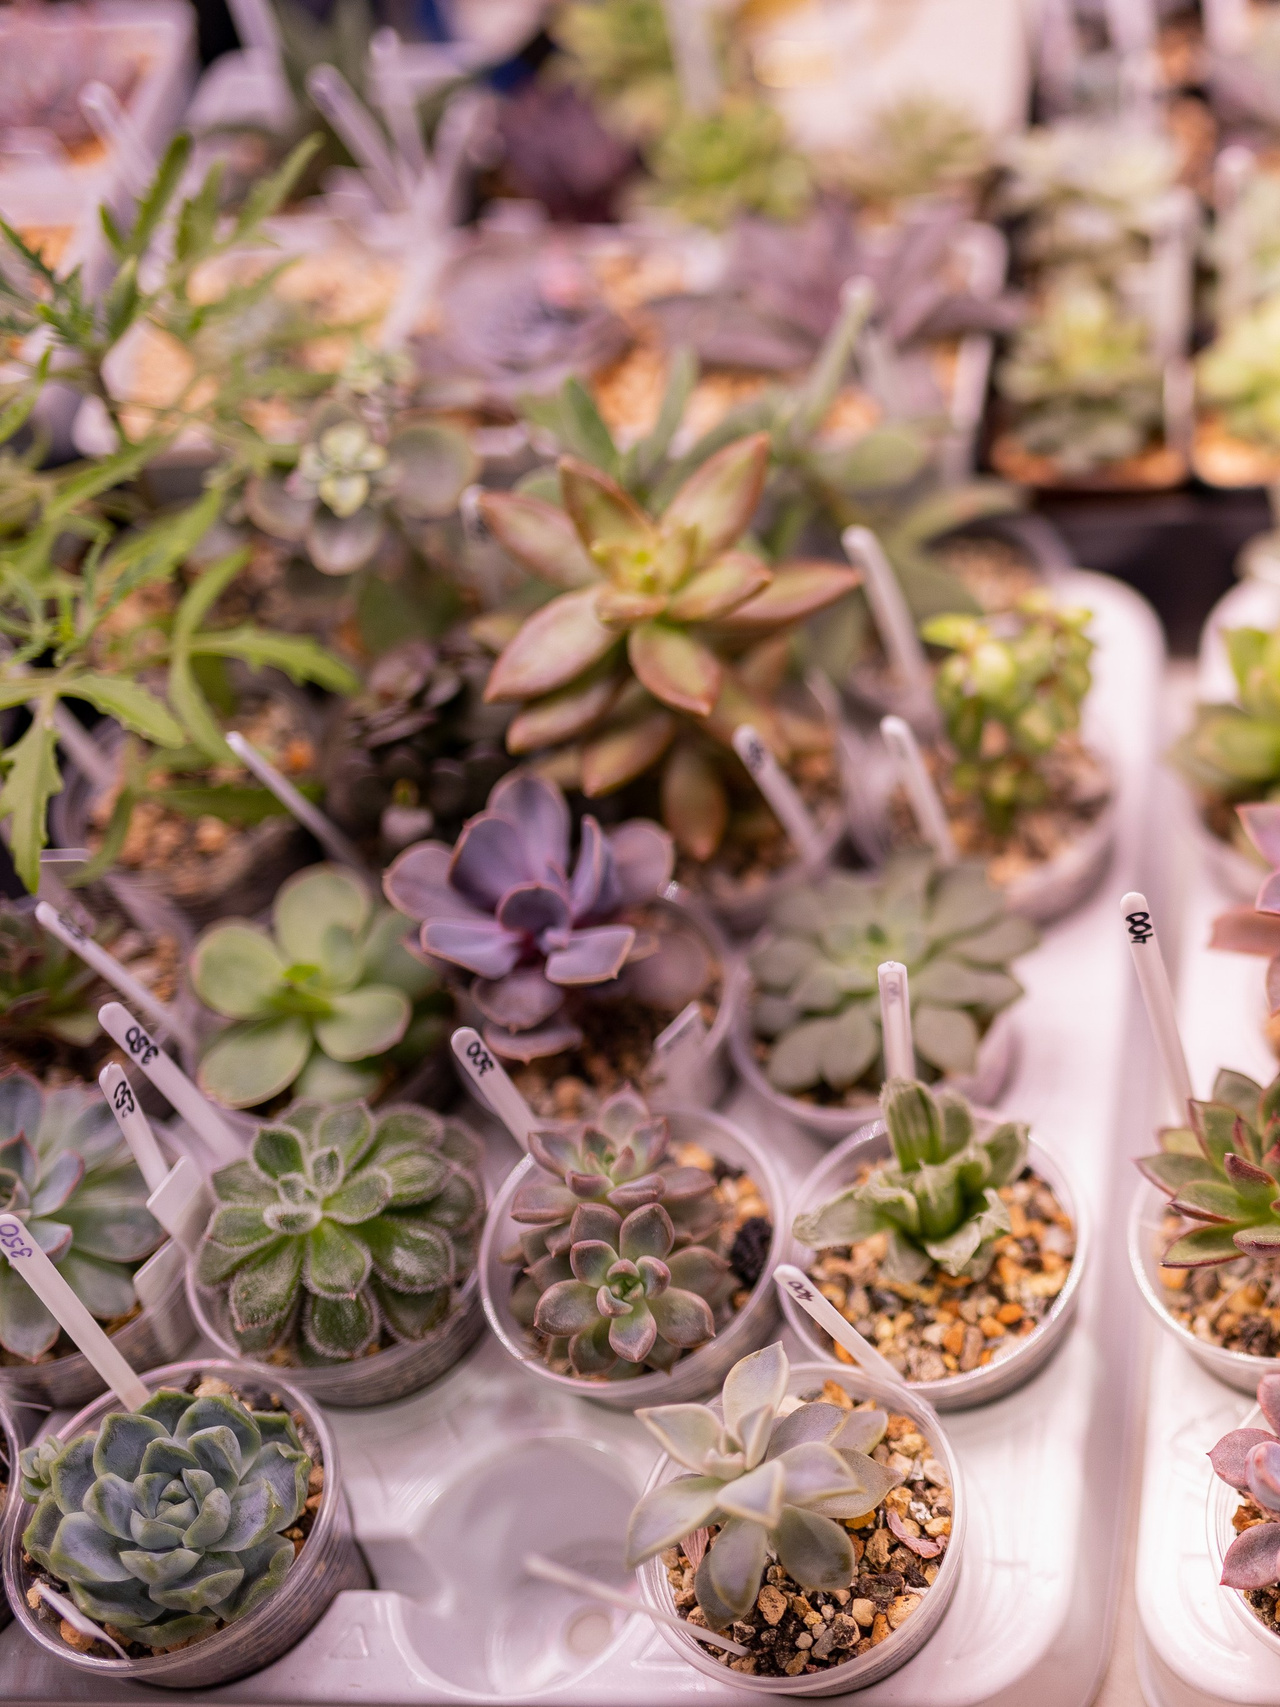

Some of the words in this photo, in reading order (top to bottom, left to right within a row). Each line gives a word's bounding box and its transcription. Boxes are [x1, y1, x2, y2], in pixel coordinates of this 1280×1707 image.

[1125, 911, 1153, 944] 400
[125, 1026, 159, 1066] 350
[0, 1223, 33, 1258] 350
[787, 1281, 815, 1302] 400
